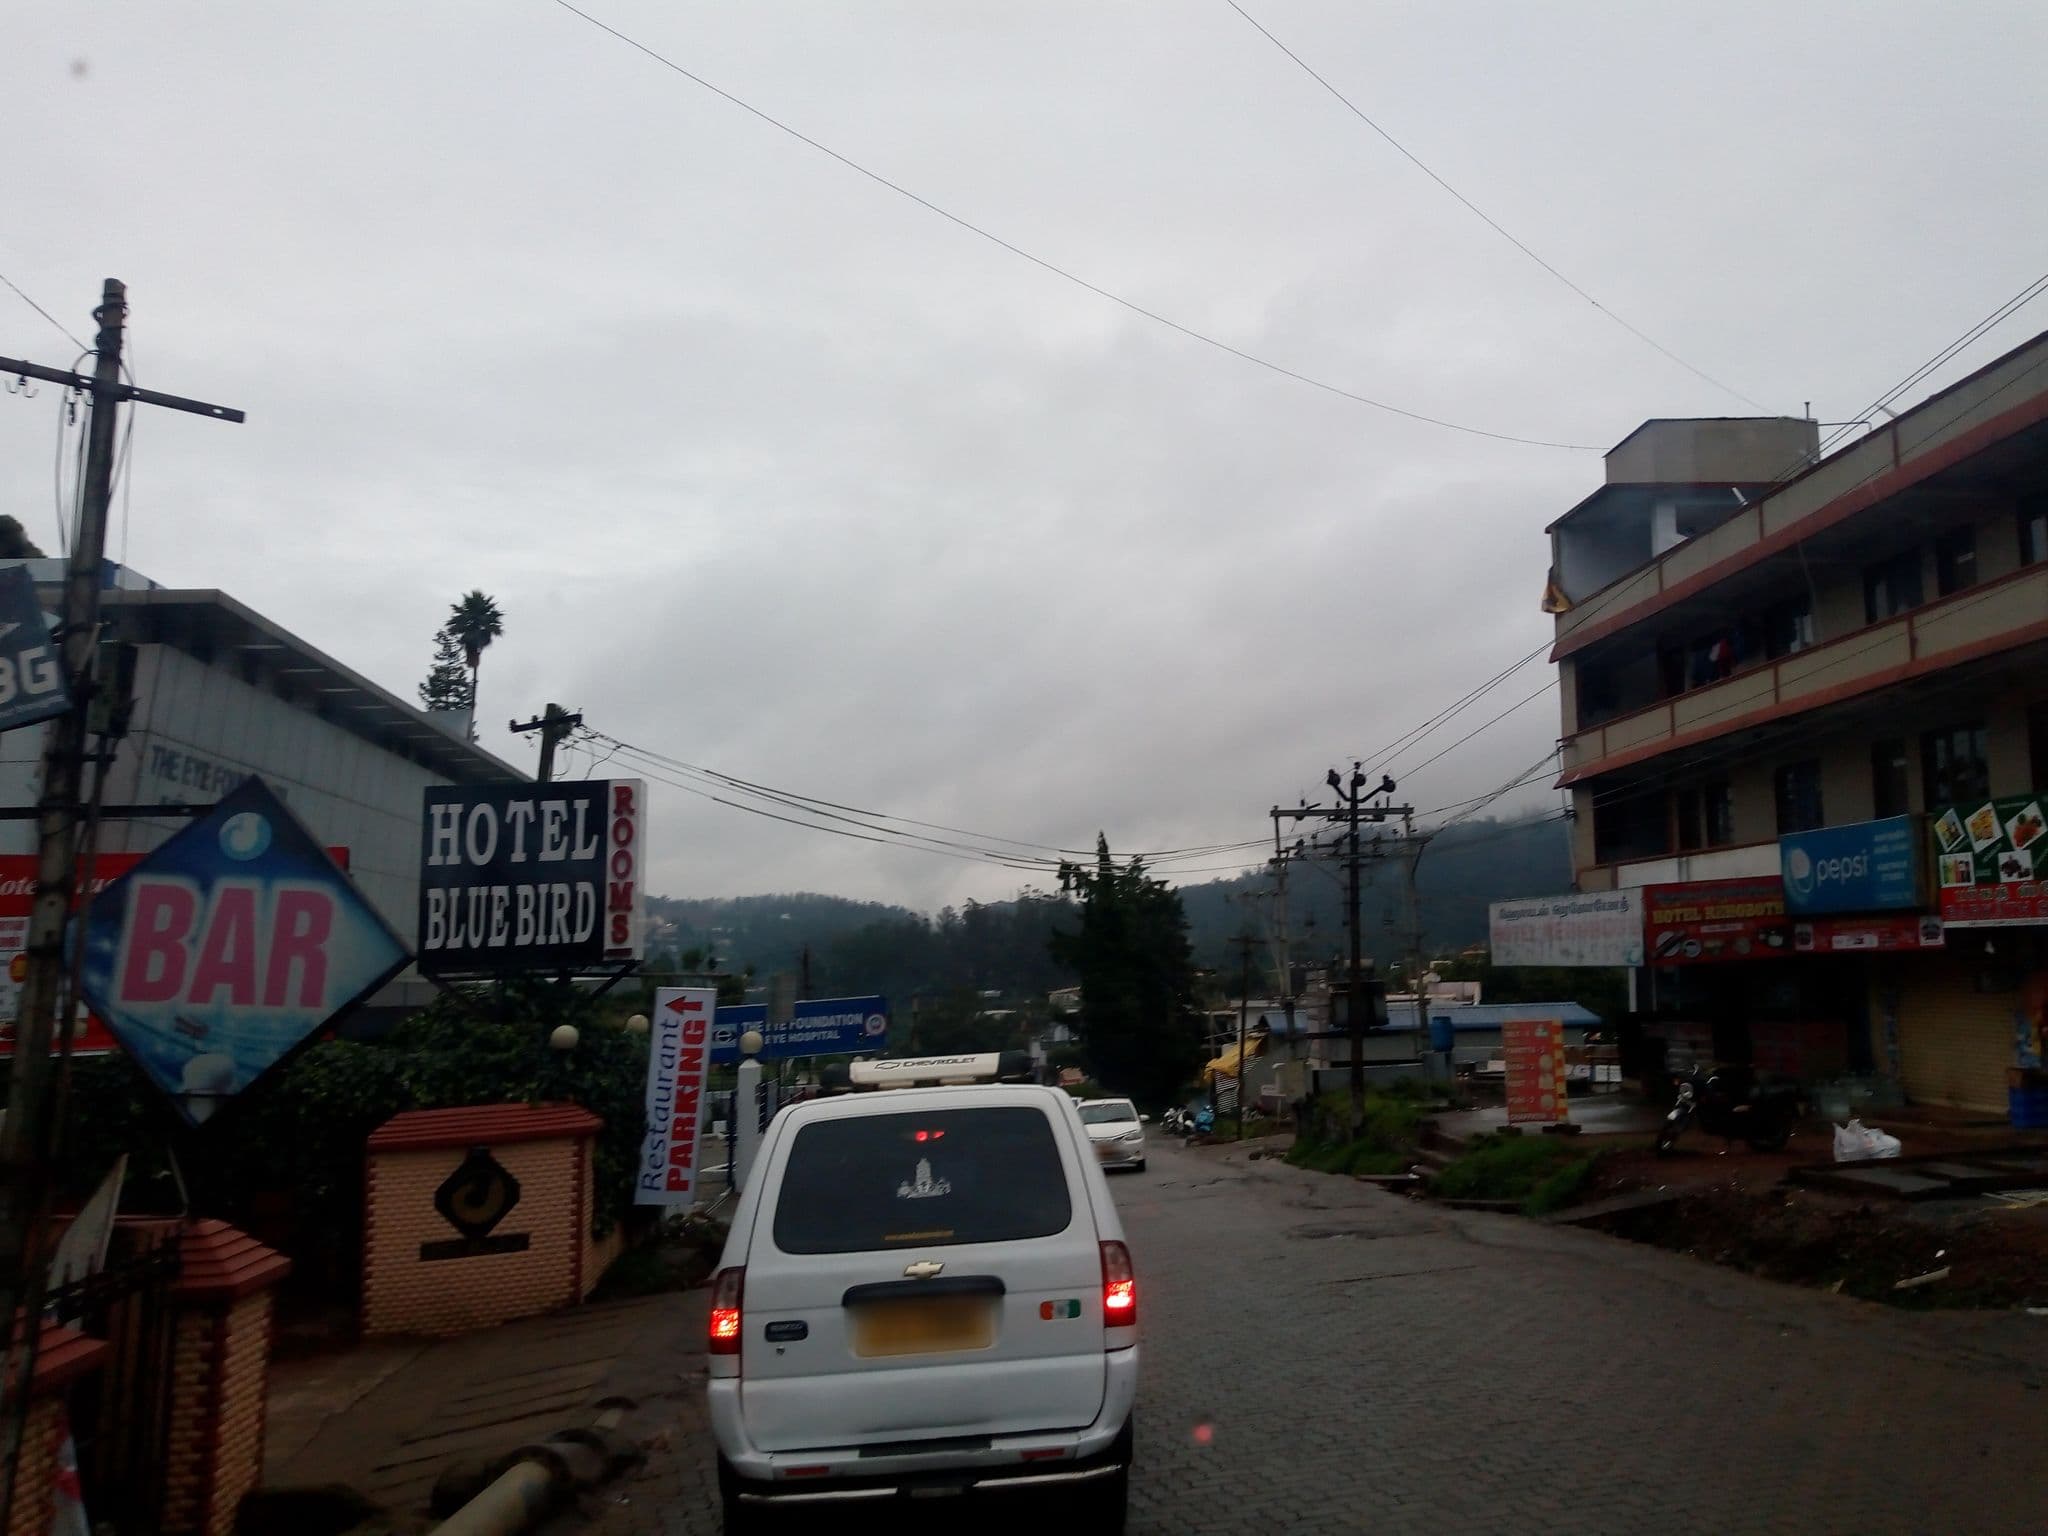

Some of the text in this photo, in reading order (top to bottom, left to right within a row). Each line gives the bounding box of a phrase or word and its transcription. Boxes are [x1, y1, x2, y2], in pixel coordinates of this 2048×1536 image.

[427, 799, 599, 866] HOTEL
[0, 875, 40, 896] ote
[607, 786, 636, 945] ROOMS
[1816, 848, 1869, 887] pepsi
[120, 883, 334, 1008] BAR
[741, 1020, 764, 1032] THE
[789, 1012, 864, 1031] FOUNDATION
[789, 1030, 843, 1044] HOSPITAL
[902, 1057, 977, 1067] CHEVROLET
[640, 1018, 680, 1191] Restaurant
[666, 1019, 707, 1191] PARKING
